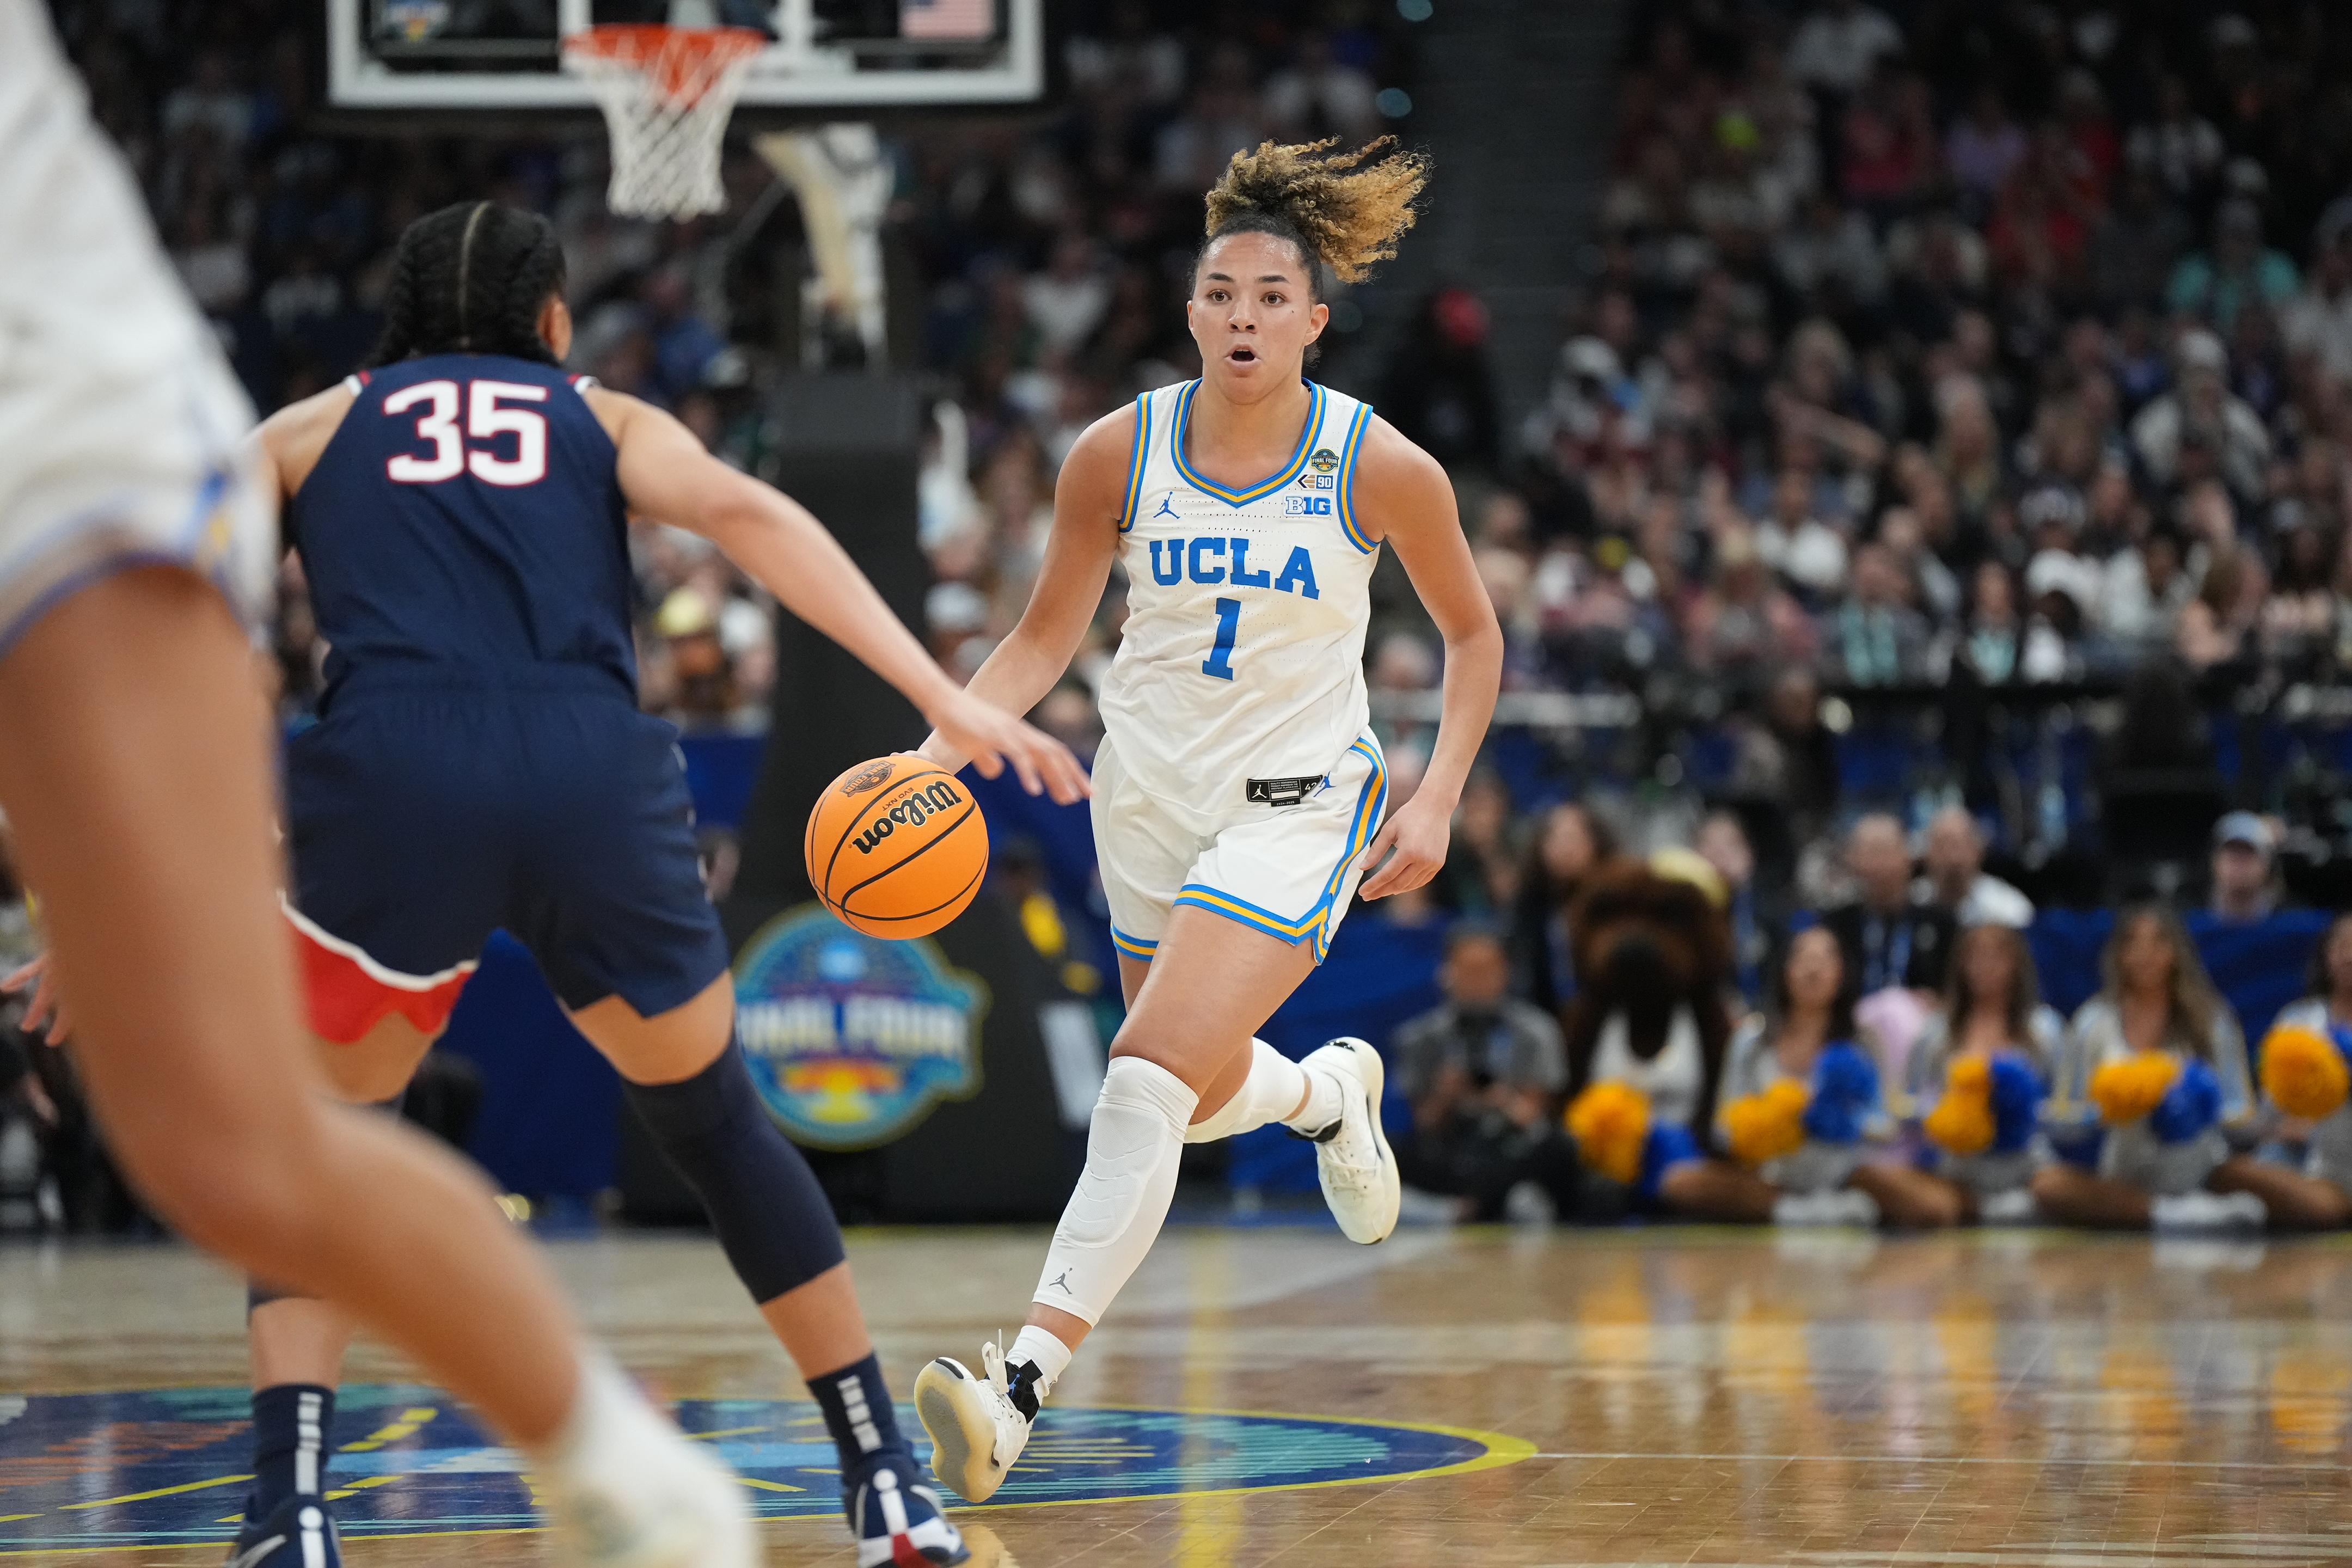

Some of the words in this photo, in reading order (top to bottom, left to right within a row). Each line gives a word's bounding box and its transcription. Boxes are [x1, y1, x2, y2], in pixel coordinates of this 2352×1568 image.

[382, 379, 549, 487] 35
[1318, 476, 1332, 488] 90
[1149, 537, 1320, 600] UCLA
[1202, 597, 1241, 681] 1
[844, 775, 868, 793] FOUR
[883, 797, 898, 811] NXT
[898, 787, 914, 799] EVO
[852, 781, 962, 854] Wilson
